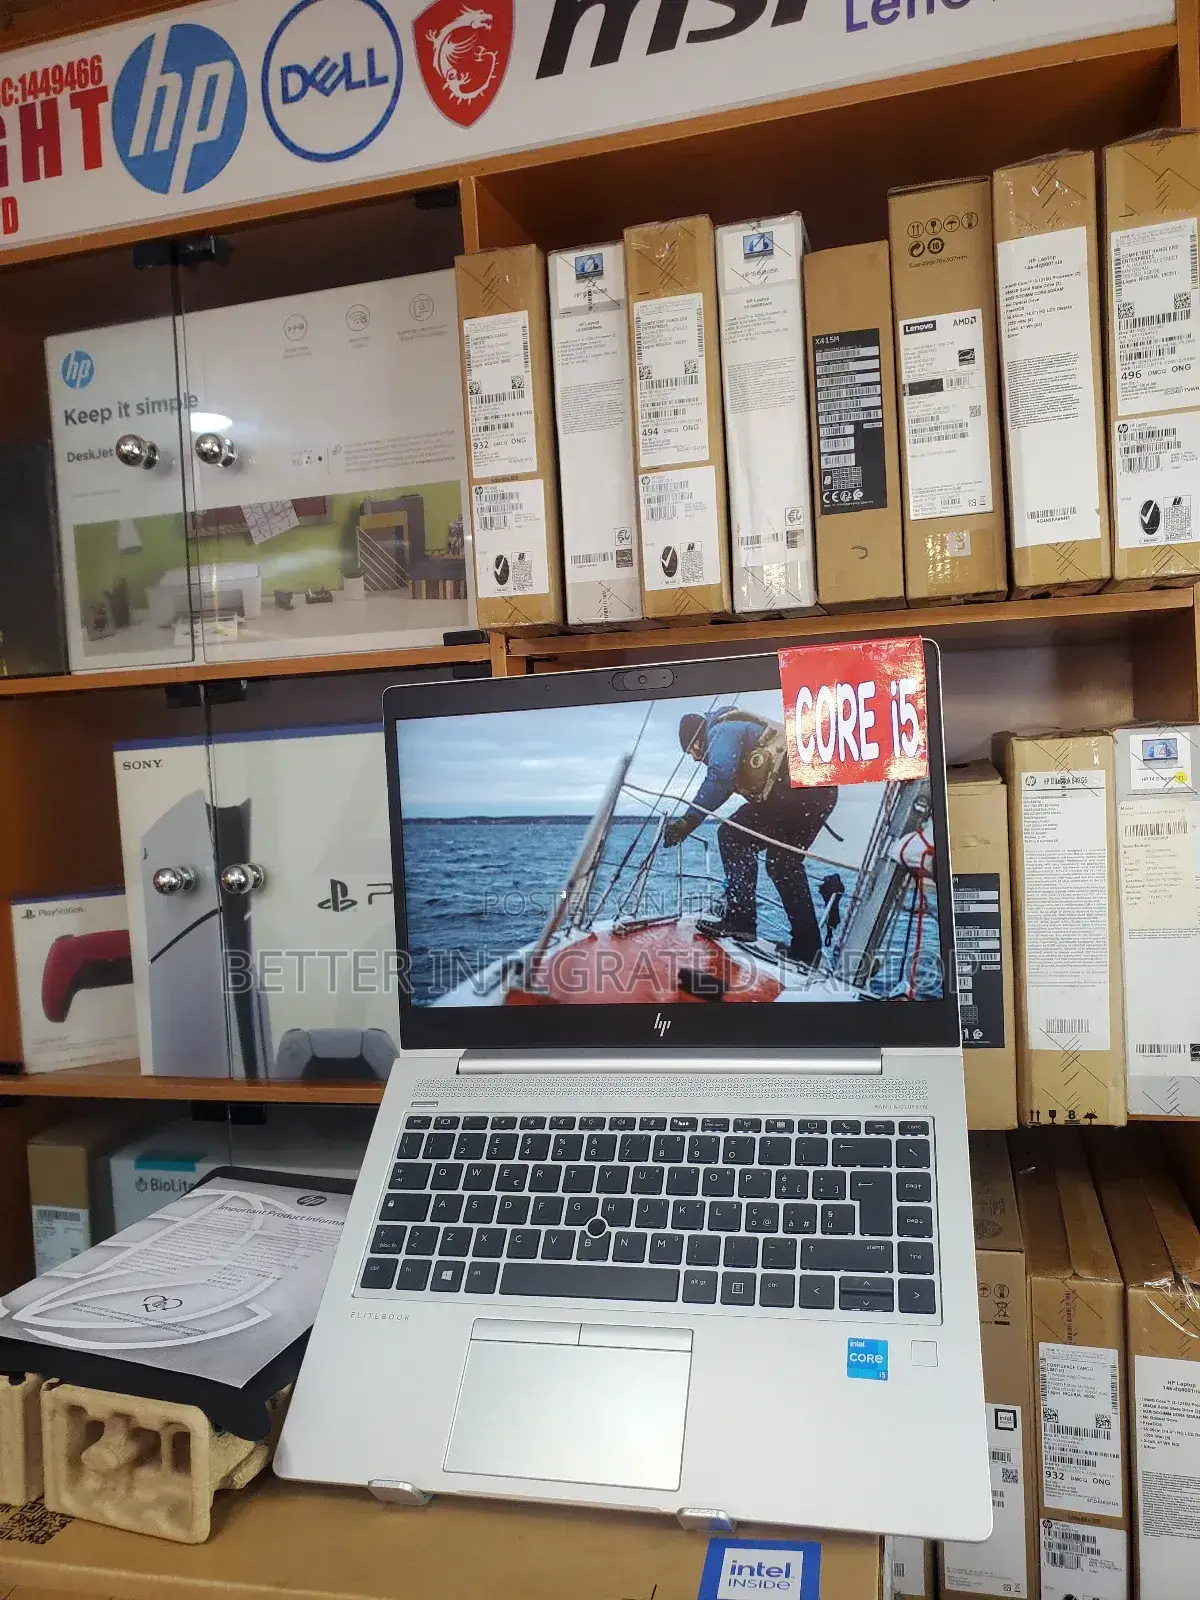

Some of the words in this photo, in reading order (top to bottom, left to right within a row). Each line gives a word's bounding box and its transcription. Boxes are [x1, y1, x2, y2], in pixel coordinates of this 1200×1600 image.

[280, 47, 390, 104] DELL
[0, 54, 103, 108] C:1449466
[129, 24, 234, 194] hp
[953, 317, 970, 327] AMD
[905, 323, 934, 332] Lenovo
[814, 336, 840, 346] X415M
[65, 352, 93, 388] hp
[1121, 370, 1142, 380] 496
[1171, 363, 1191, 373] ONG
[63, 404, 113, 427] Keep
[117, 401, 131, 418] it
[136, 392, 199, 415] simple
[642, 427, 659, 437] 494
[683, 423, 699, 431] ONG
[473, 440, 489, 450] 932
[511, 437, 527, 445] ONG
[66, 446, 115, 463] DeskJet
[795, 680, 880, 764] CORE
[889, 677, 920, 758] i5
[122, 759, 162, 771] SONY
[38, 905, 84, 918] PlayStation
[439, 1168, 448, 1177] Q
[471, 1168, 482, 1177] W
[503, 1169, 510, 1177] E
[536, 1170, 543, 1178] R
[569, 1170, 577, 1178] T
[605, 1171, 612, 1179] Y
[638, 1171, 646, 1180] U
[710, 1173, 718, 1182] O
[745, 1174, 752, 1182] P
[472, 1201, 478, 1209] S
[505, 1201, 512, 1209] D
[539, 1202, 545, 1210] F
[573, 1203, 581, 1211] G
[218, 1204, 267, 1216] Important
[267, 1210, 306, 1221] Product
[679, 1206, 686, 1214] K
[716, 1208, 721, 1216] L
[447, 1233, 454, 1241] Z
[481, 1234, 488, 1242] X
[515, 1235, 522, 1243] C
[551, 1235, 558, 1243] V
[584, 1239, 591, 1247] B
[657, 1240, 666, 1248] M
[350, 1311, 412, 1322] ELITEBOOK
[850, 1340, 866, 1348] intel
[879, 1371, 886, 1379] i5
[1045, 1470, 1065, 1481] 932
[1092, 1477, 1111, 1486] ONG
[730, 1560, 792, 1579] intel
